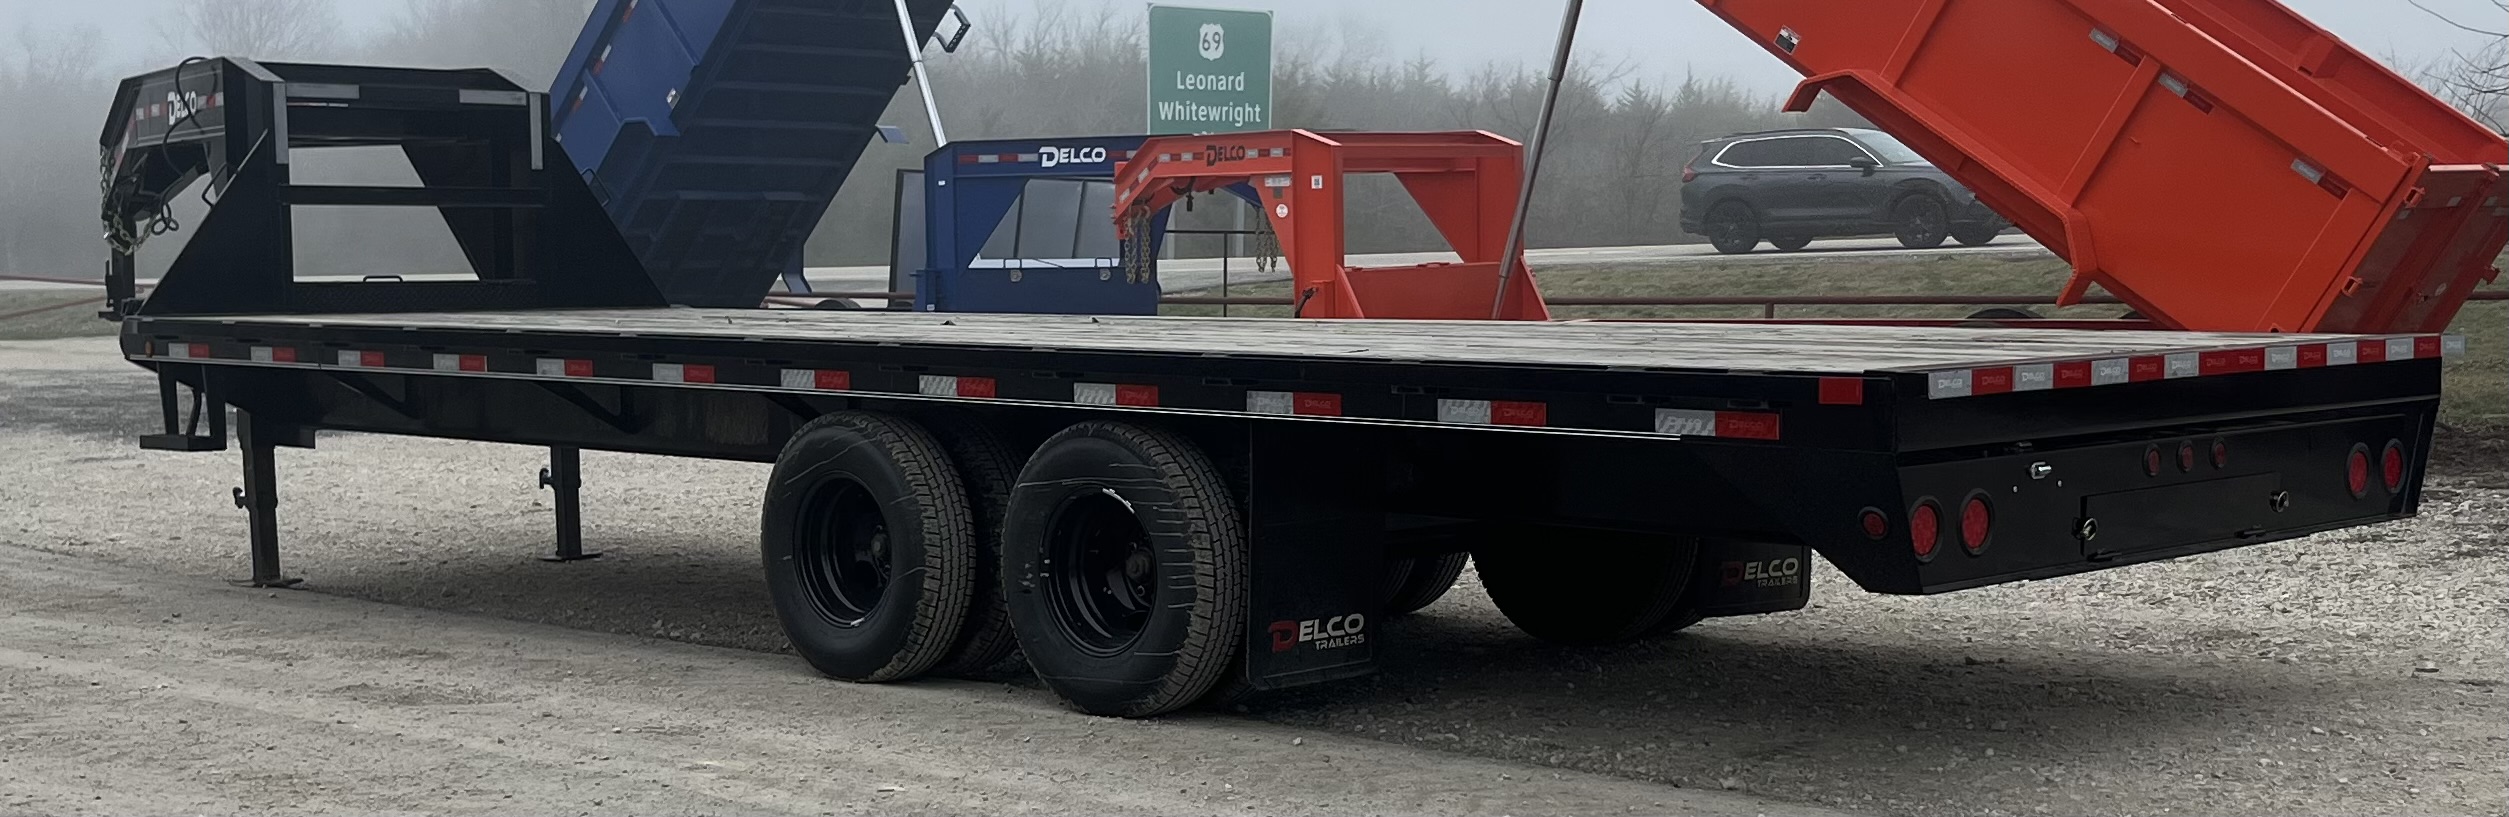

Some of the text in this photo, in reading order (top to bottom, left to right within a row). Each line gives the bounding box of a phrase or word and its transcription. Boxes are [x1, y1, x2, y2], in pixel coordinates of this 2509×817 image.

[1202, 31, 1221, 51] 69
[1176, 70, 1245, 91] Leonard
[1158, 100, 1262, 127] Whitewright
[1038, 146, 1107, 168] DELCO
[1205, 145, 1246, 166] DELCO
[1721, 557, 1799, 587] DELCO
[1268, 613, 1365, 653] DELCO
[1315, 633, 1365, 650] TRAILERS
